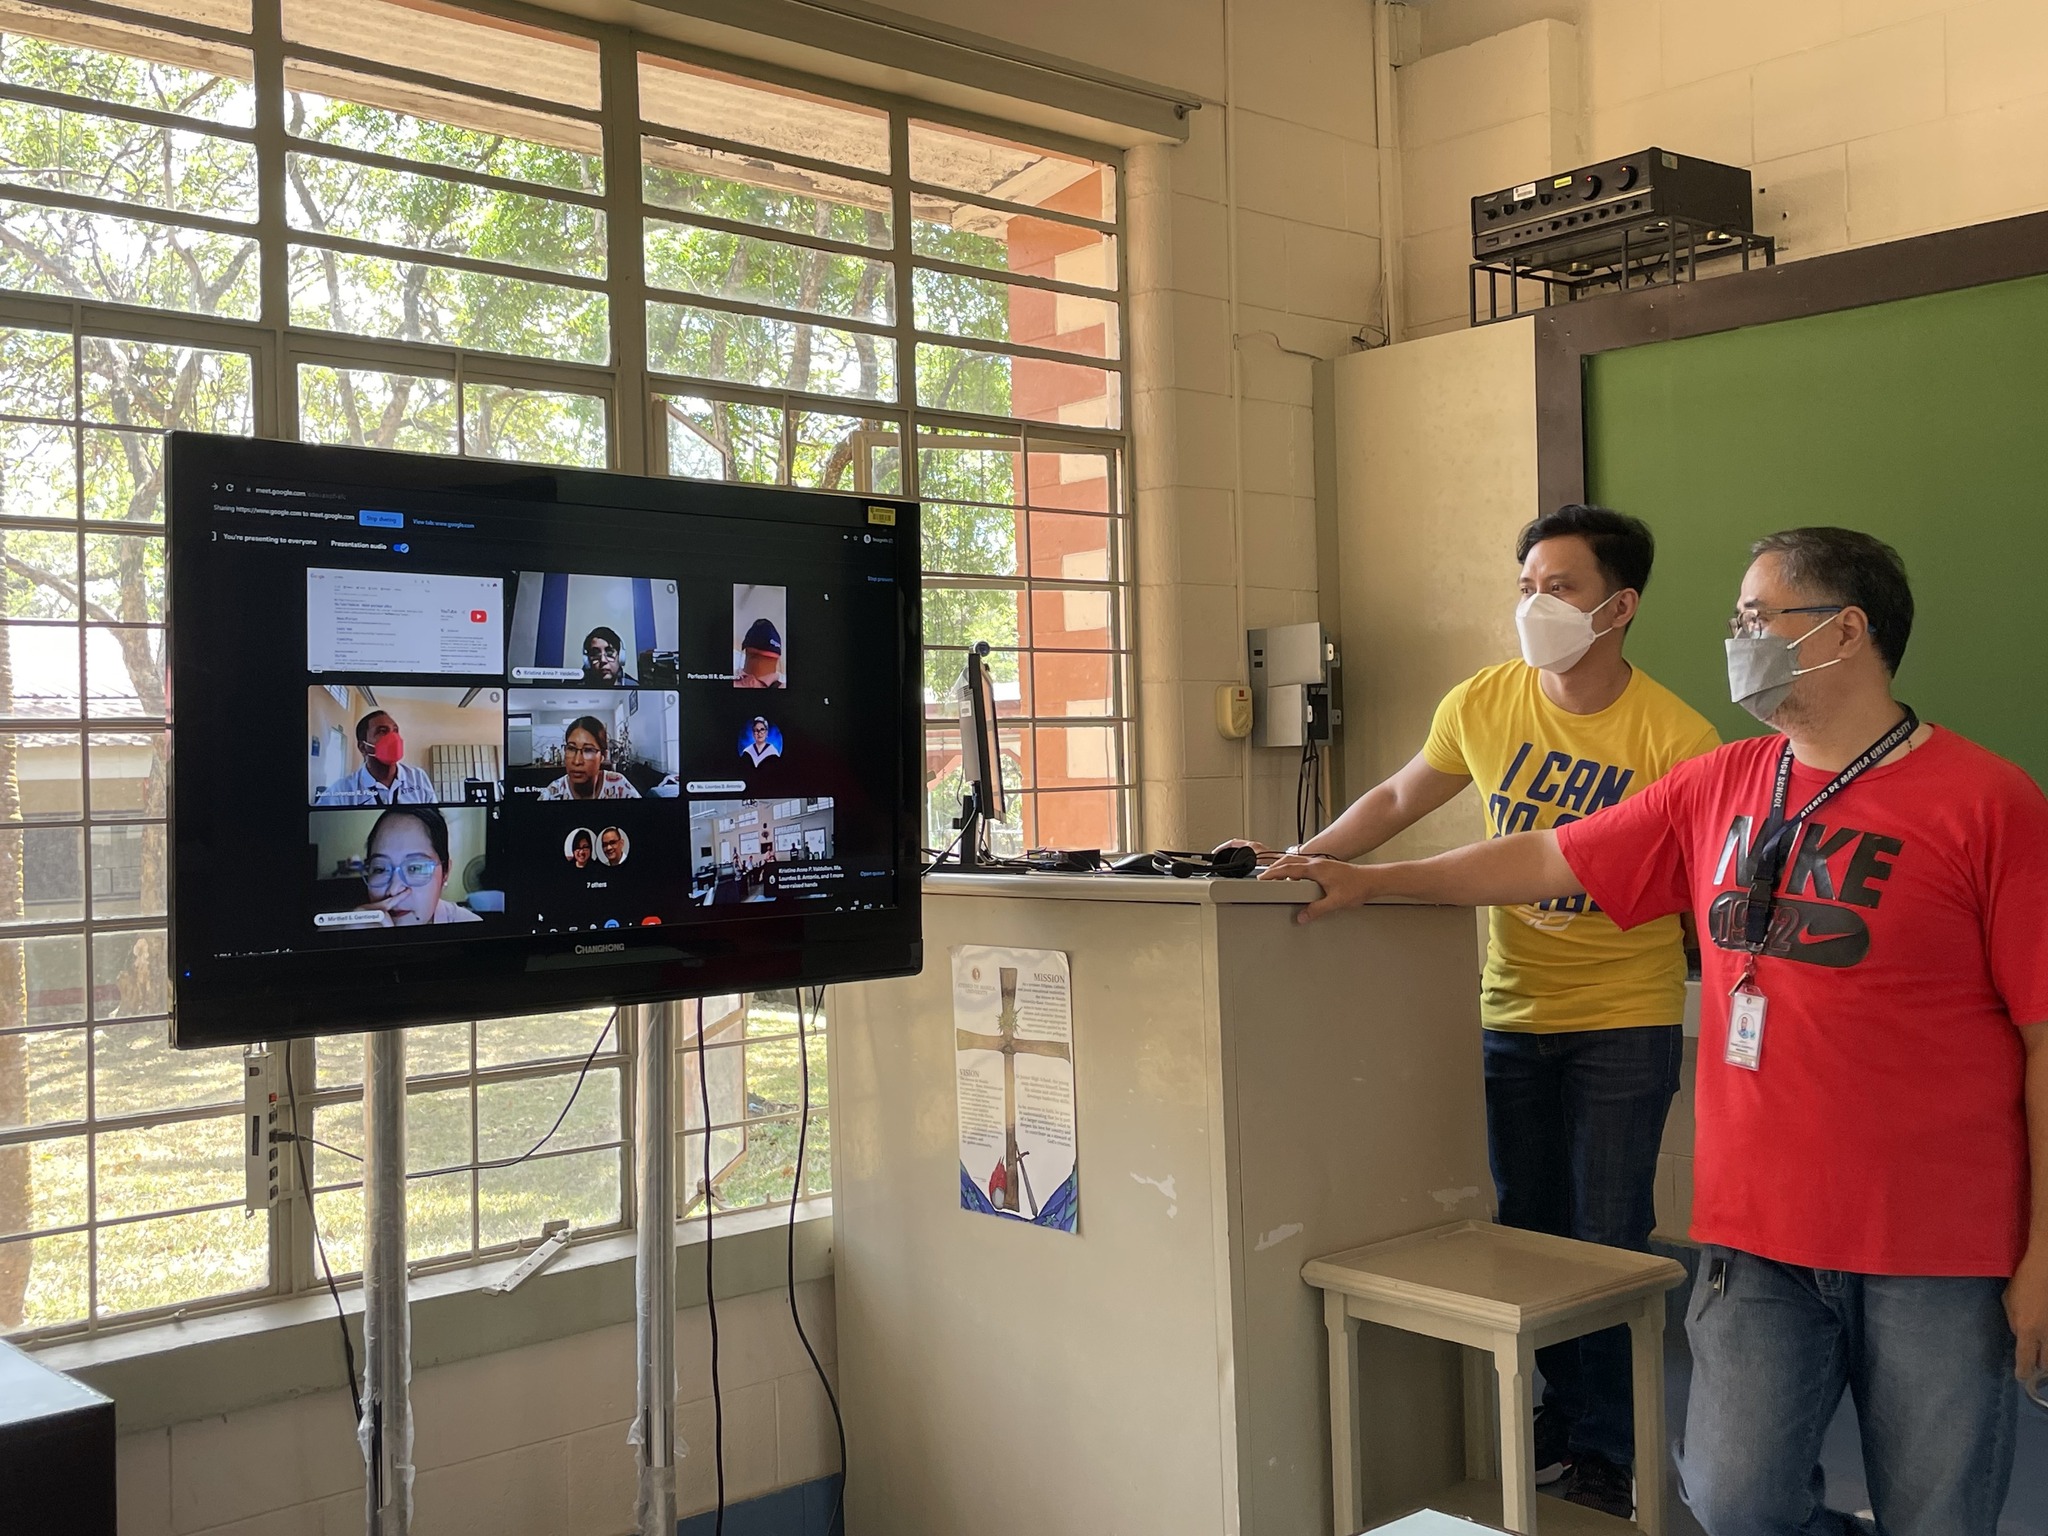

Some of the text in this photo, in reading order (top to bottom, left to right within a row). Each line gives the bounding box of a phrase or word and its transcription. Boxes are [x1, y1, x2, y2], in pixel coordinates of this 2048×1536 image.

[256, 488, 306, 496] meet.google.com
[244, 534, 278, 544] presenting
[330, 540, 369, 549] Presentation
[1779, 756, 1790, 774] HIGH
[1800, 720, 1912, 818] ATENEO DE MANILA UNIVERSITY
[1500, 742, 1635, 816] I CAN
[1773, 776, 1786, 808] SCHOOL
[1713, 815, 1905, 909] NIKE
[1714, 897, 1799, 952] 192
[575, 943, 625, 954] CHANGHONG
[1034, 973, 1065, 983] MISSION
[960, 1068, 979, 1078] VISION
